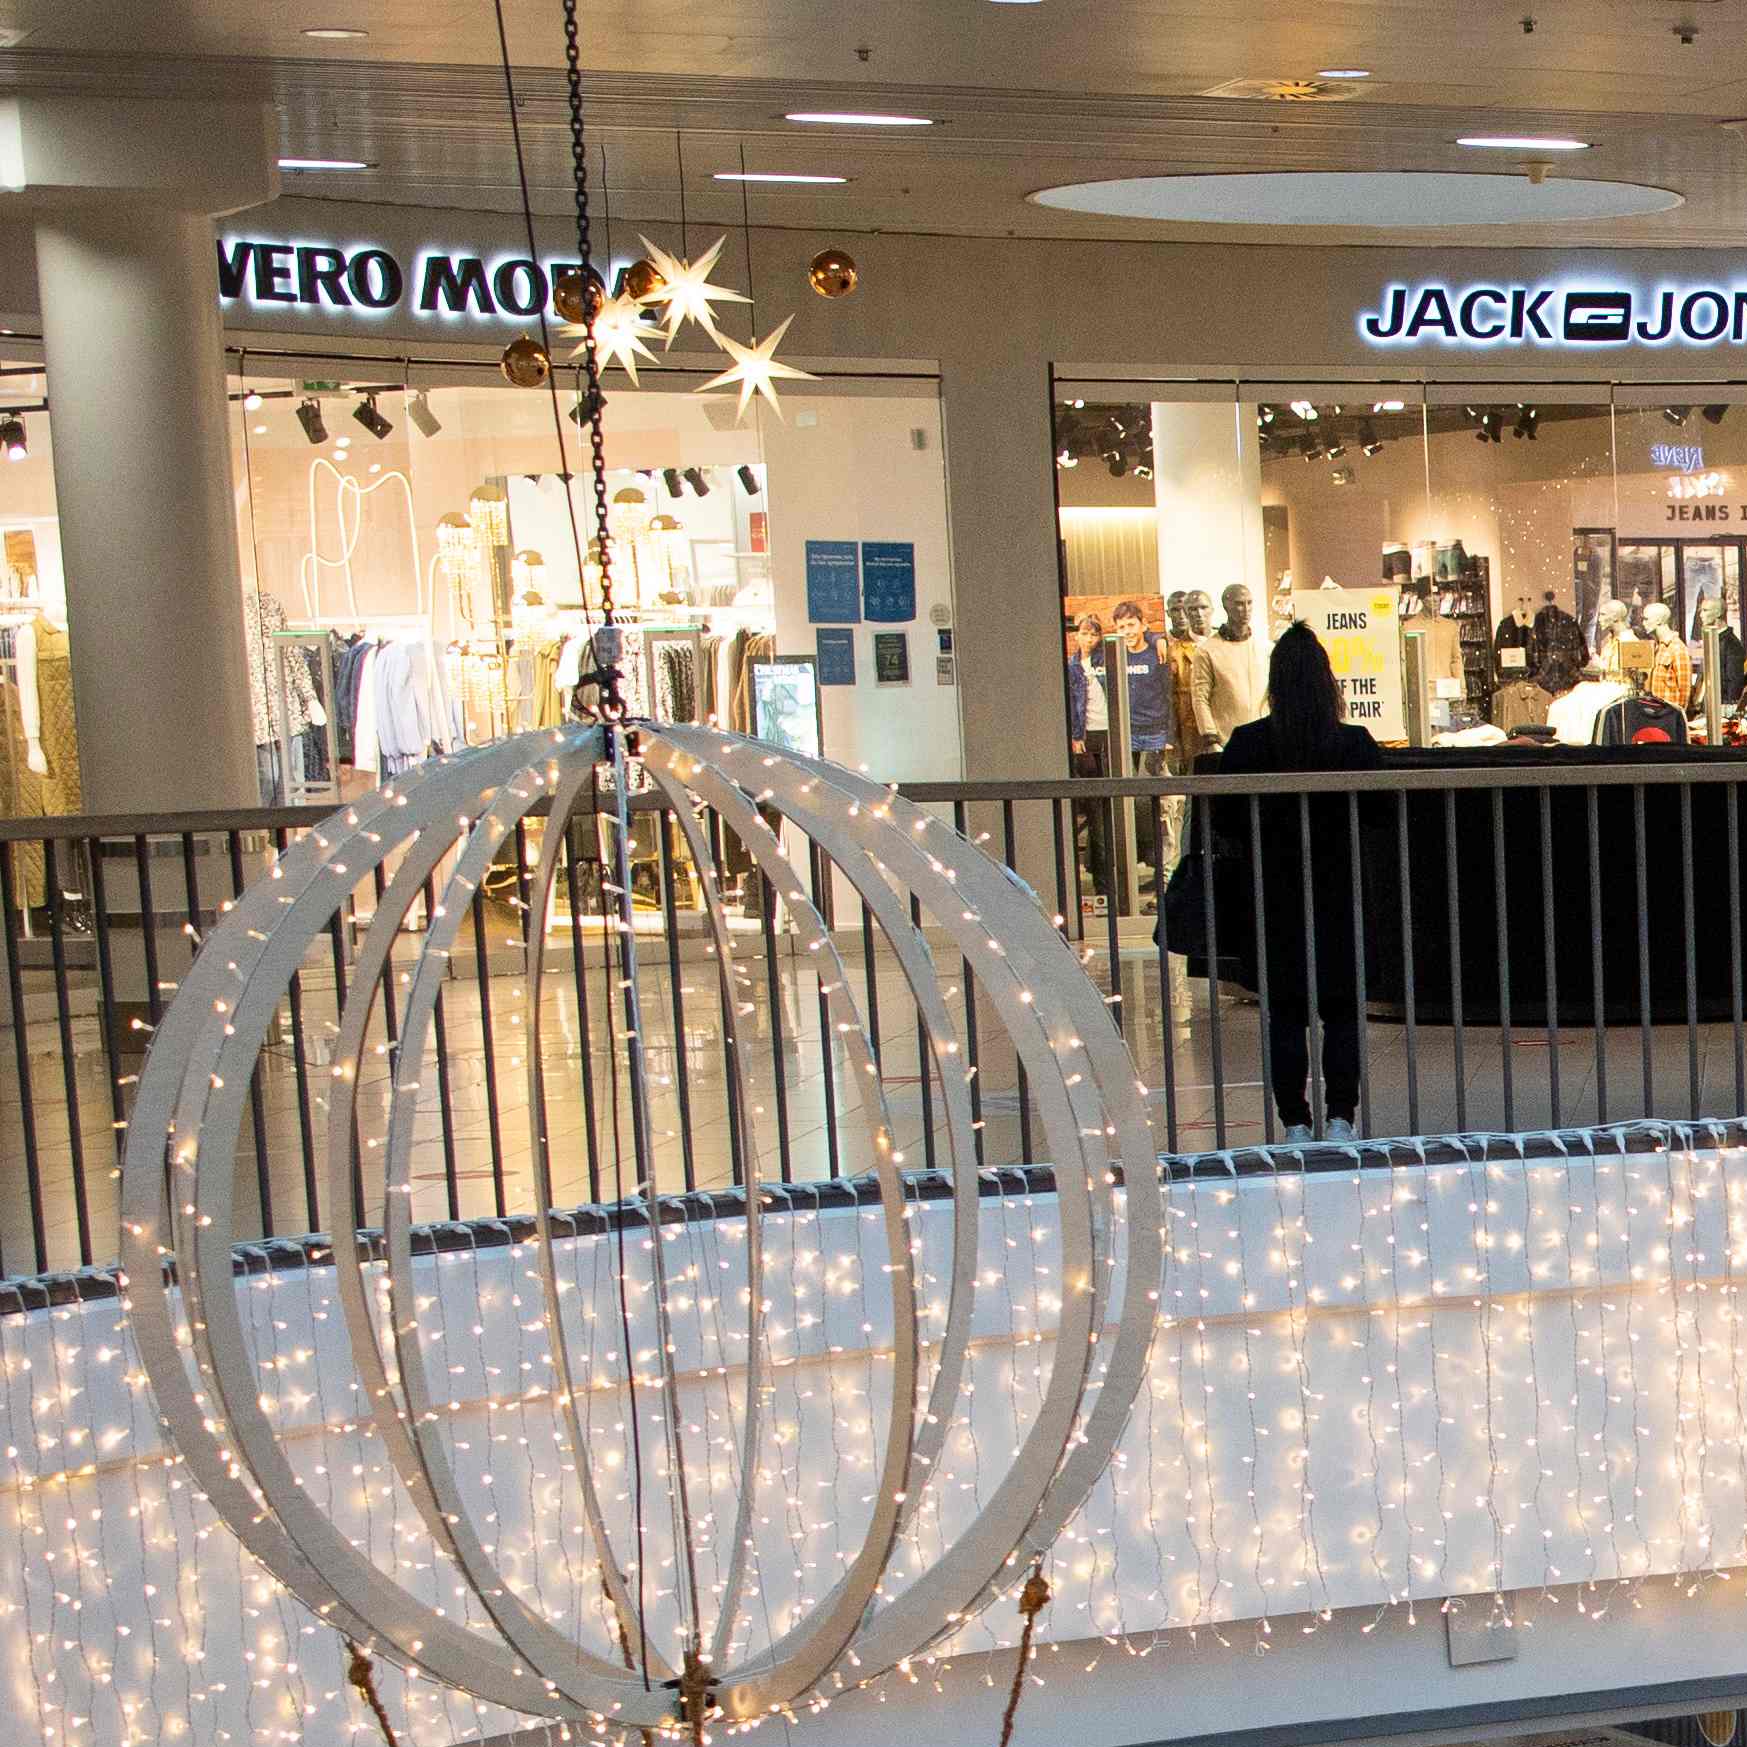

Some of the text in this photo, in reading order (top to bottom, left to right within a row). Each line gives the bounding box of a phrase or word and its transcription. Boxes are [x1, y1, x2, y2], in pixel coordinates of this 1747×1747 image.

[216, 240, 403, 309] VERO
[1366, 288, 1554, 338] JACK
[1666, 504, 1730, 521] JEANS
[1326, 612, 1368, 631] JEANS
[1351, 678, 1377, 695] THE
